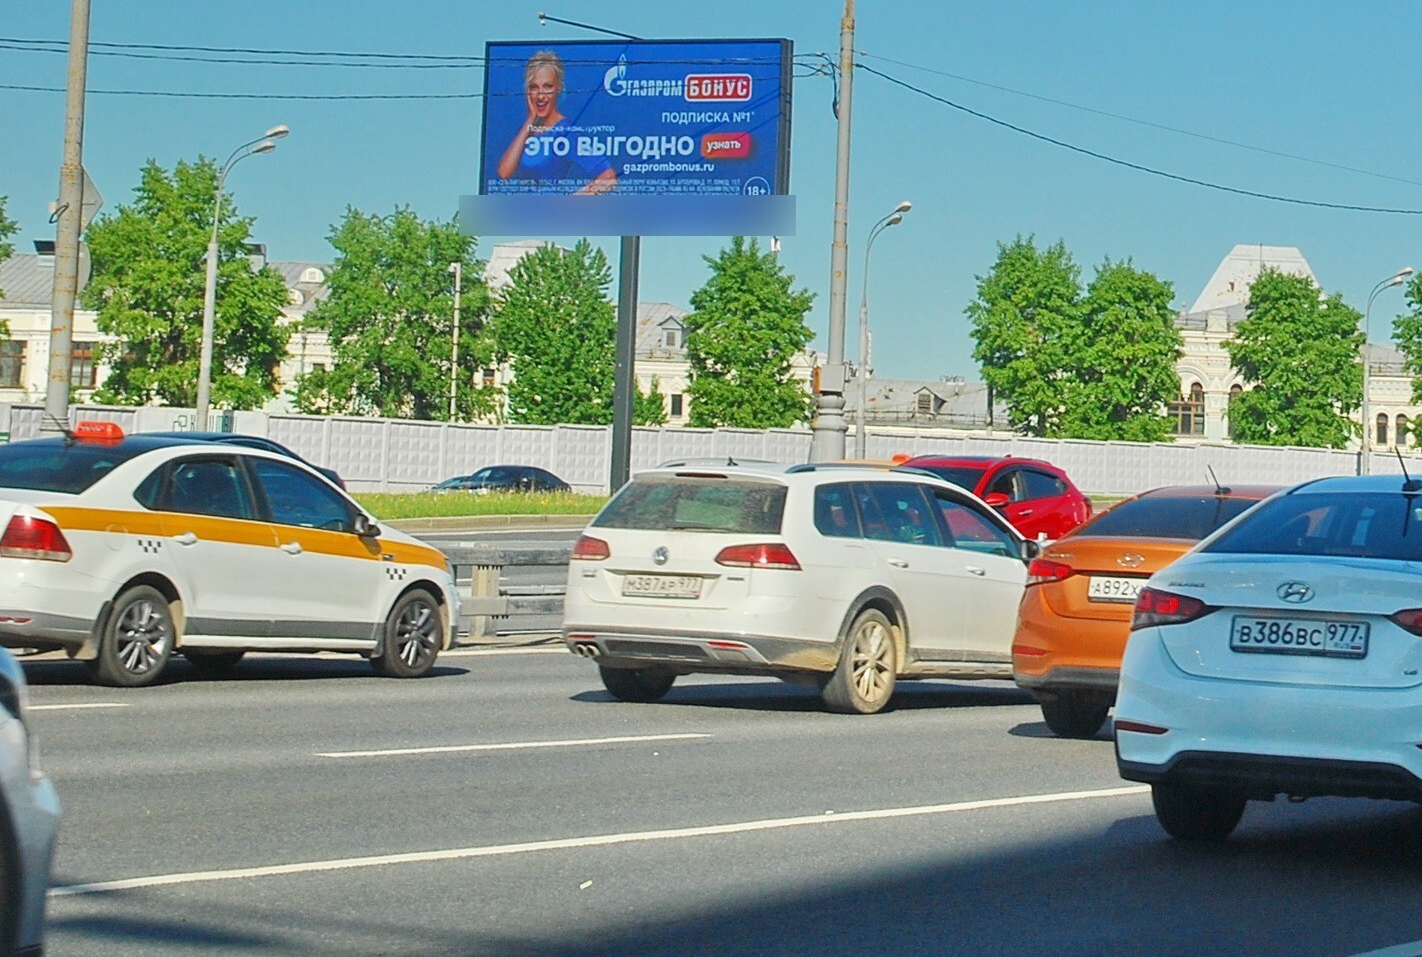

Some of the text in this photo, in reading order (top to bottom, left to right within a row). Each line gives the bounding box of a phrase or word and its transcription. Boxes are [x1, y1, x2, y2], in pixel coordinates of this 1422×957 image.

[627, 79, 748, 96] ГАЗПРОМ БОНУС
[662, 112, 730, 124] ПОДПИСКА
[525, 136, 694, 159] ЭТО ВЫГОДНО
[707, 140, 742, 152] узнать
[623, 162, 714, 174] gazprombonus.ru
[627, 577, 676, 591] М387АР
[1093, 580, 1144, 596] А892Х
[1239, 621, 1360, 647] В386ВС 977
